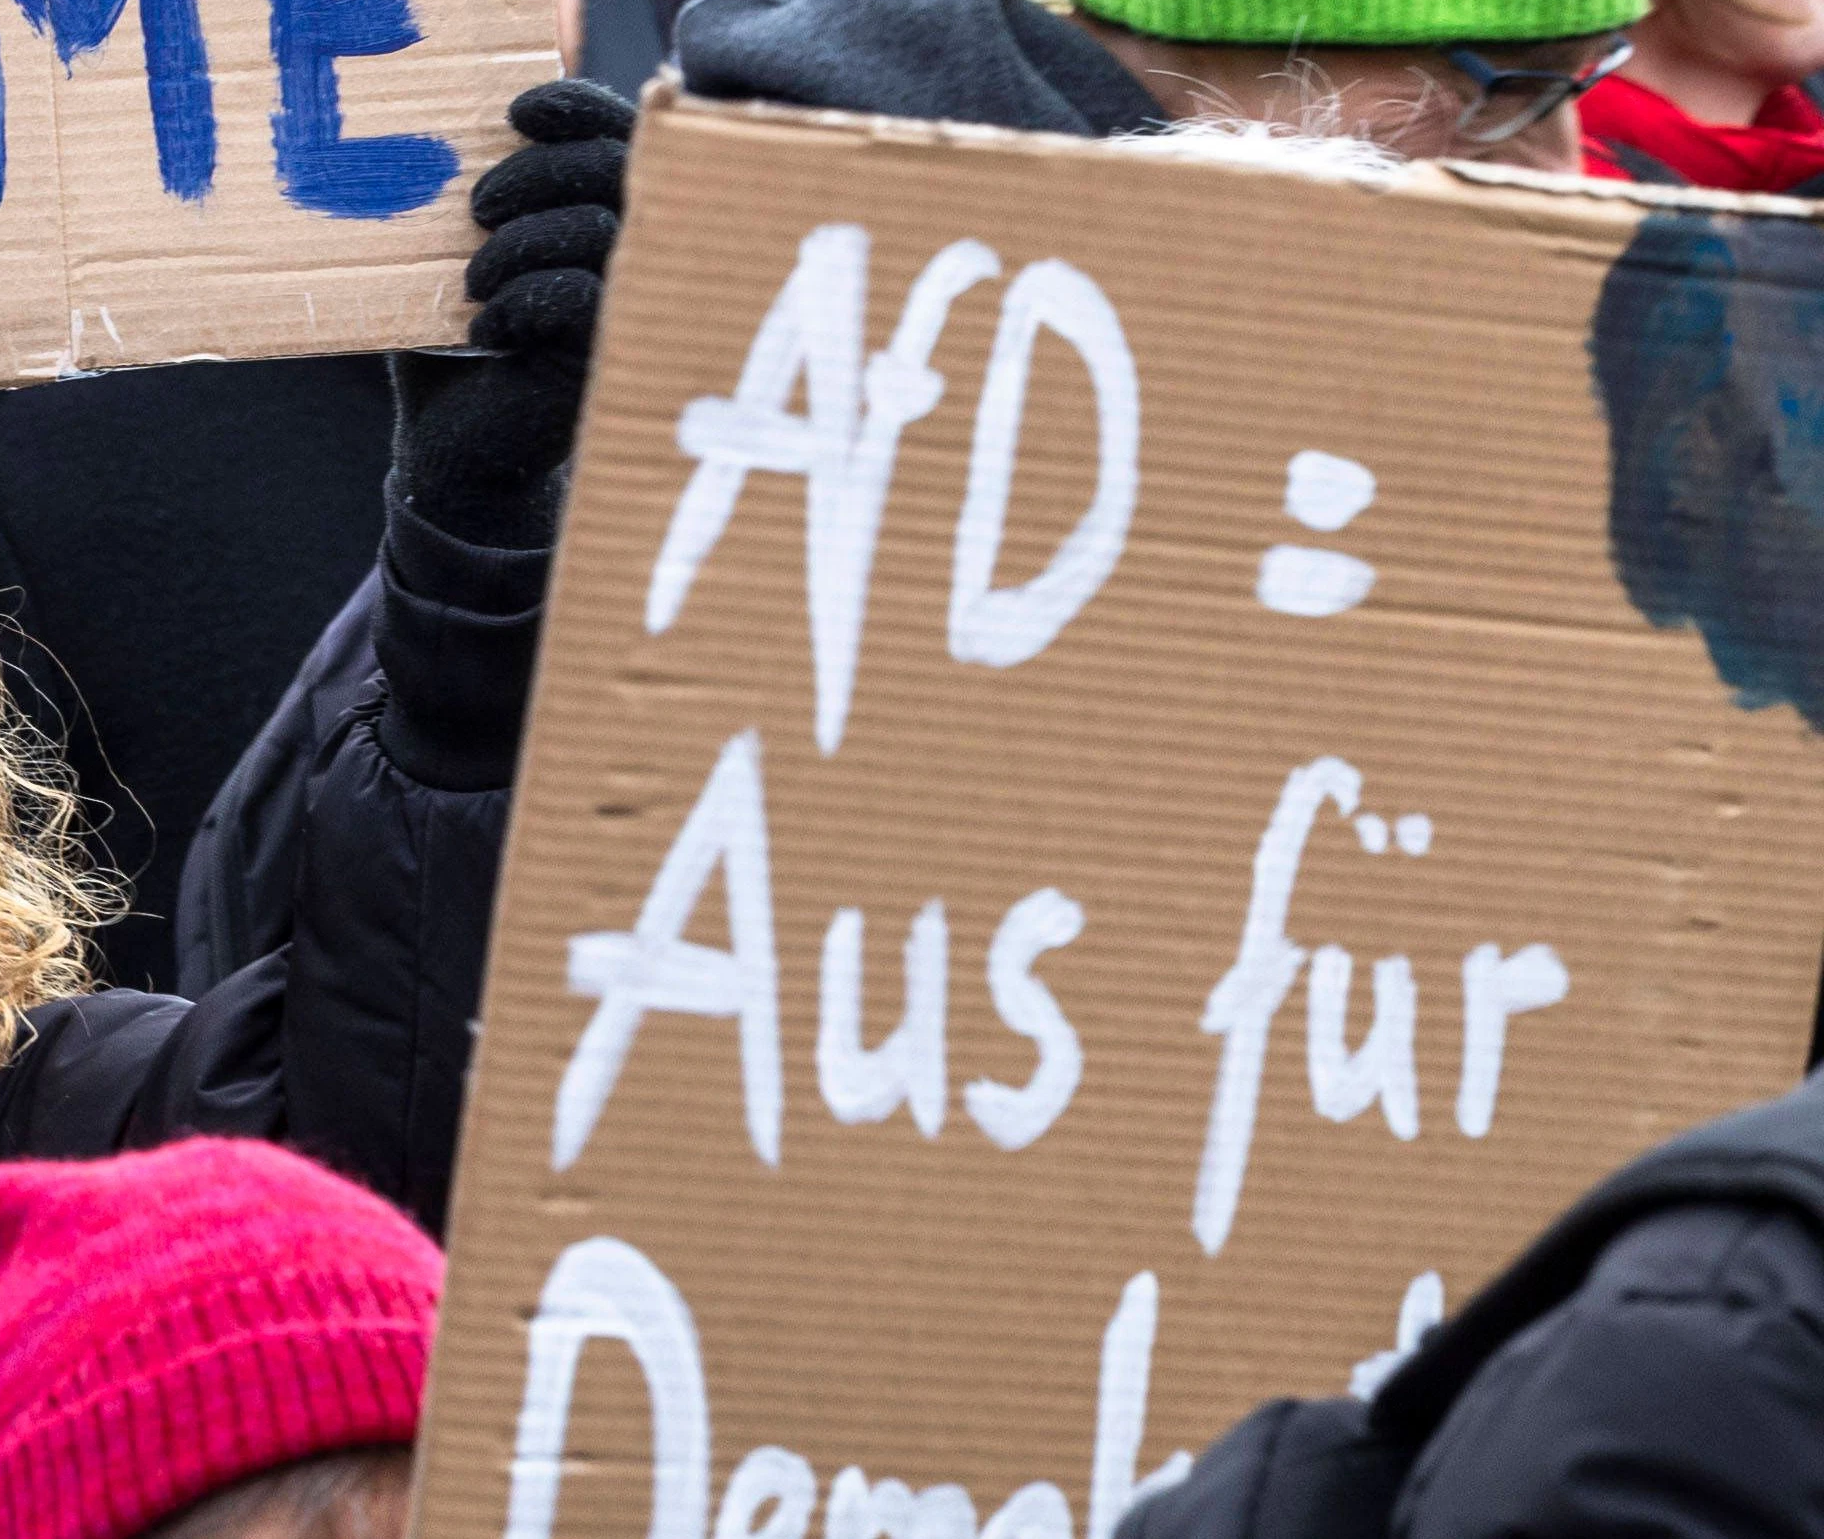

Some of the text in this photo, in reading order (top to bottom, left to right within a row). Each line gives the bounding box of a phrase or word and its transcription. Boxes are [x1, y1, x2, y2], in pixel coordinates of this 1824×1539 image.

[645, 223, 1141, 757] AfD
[552, 726, 1571, 1257] Aus für
